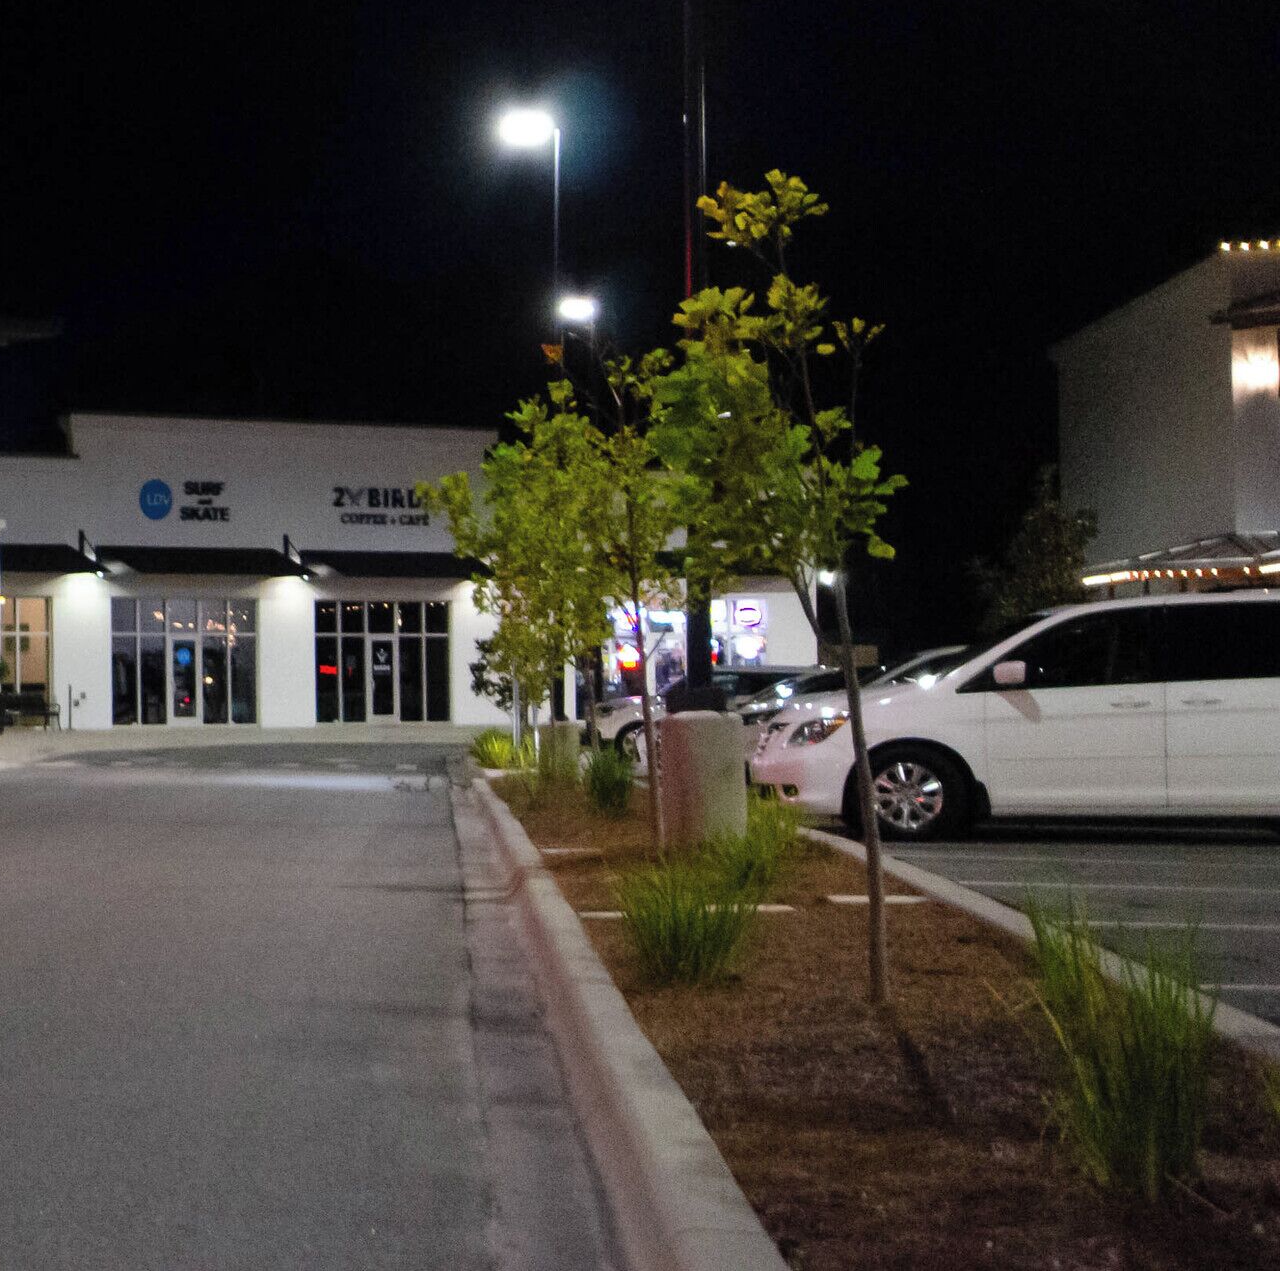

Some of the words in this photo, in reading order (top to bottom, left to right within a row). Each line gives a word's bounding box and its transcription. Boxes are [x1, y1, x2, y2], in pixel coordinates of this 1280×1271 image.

[183, 480, 225, 496] SURF
[332, 486, 345, 507] 2
[179, 507, 230, 522] SKATE
[340, 513, 388, 525] COFFEE
